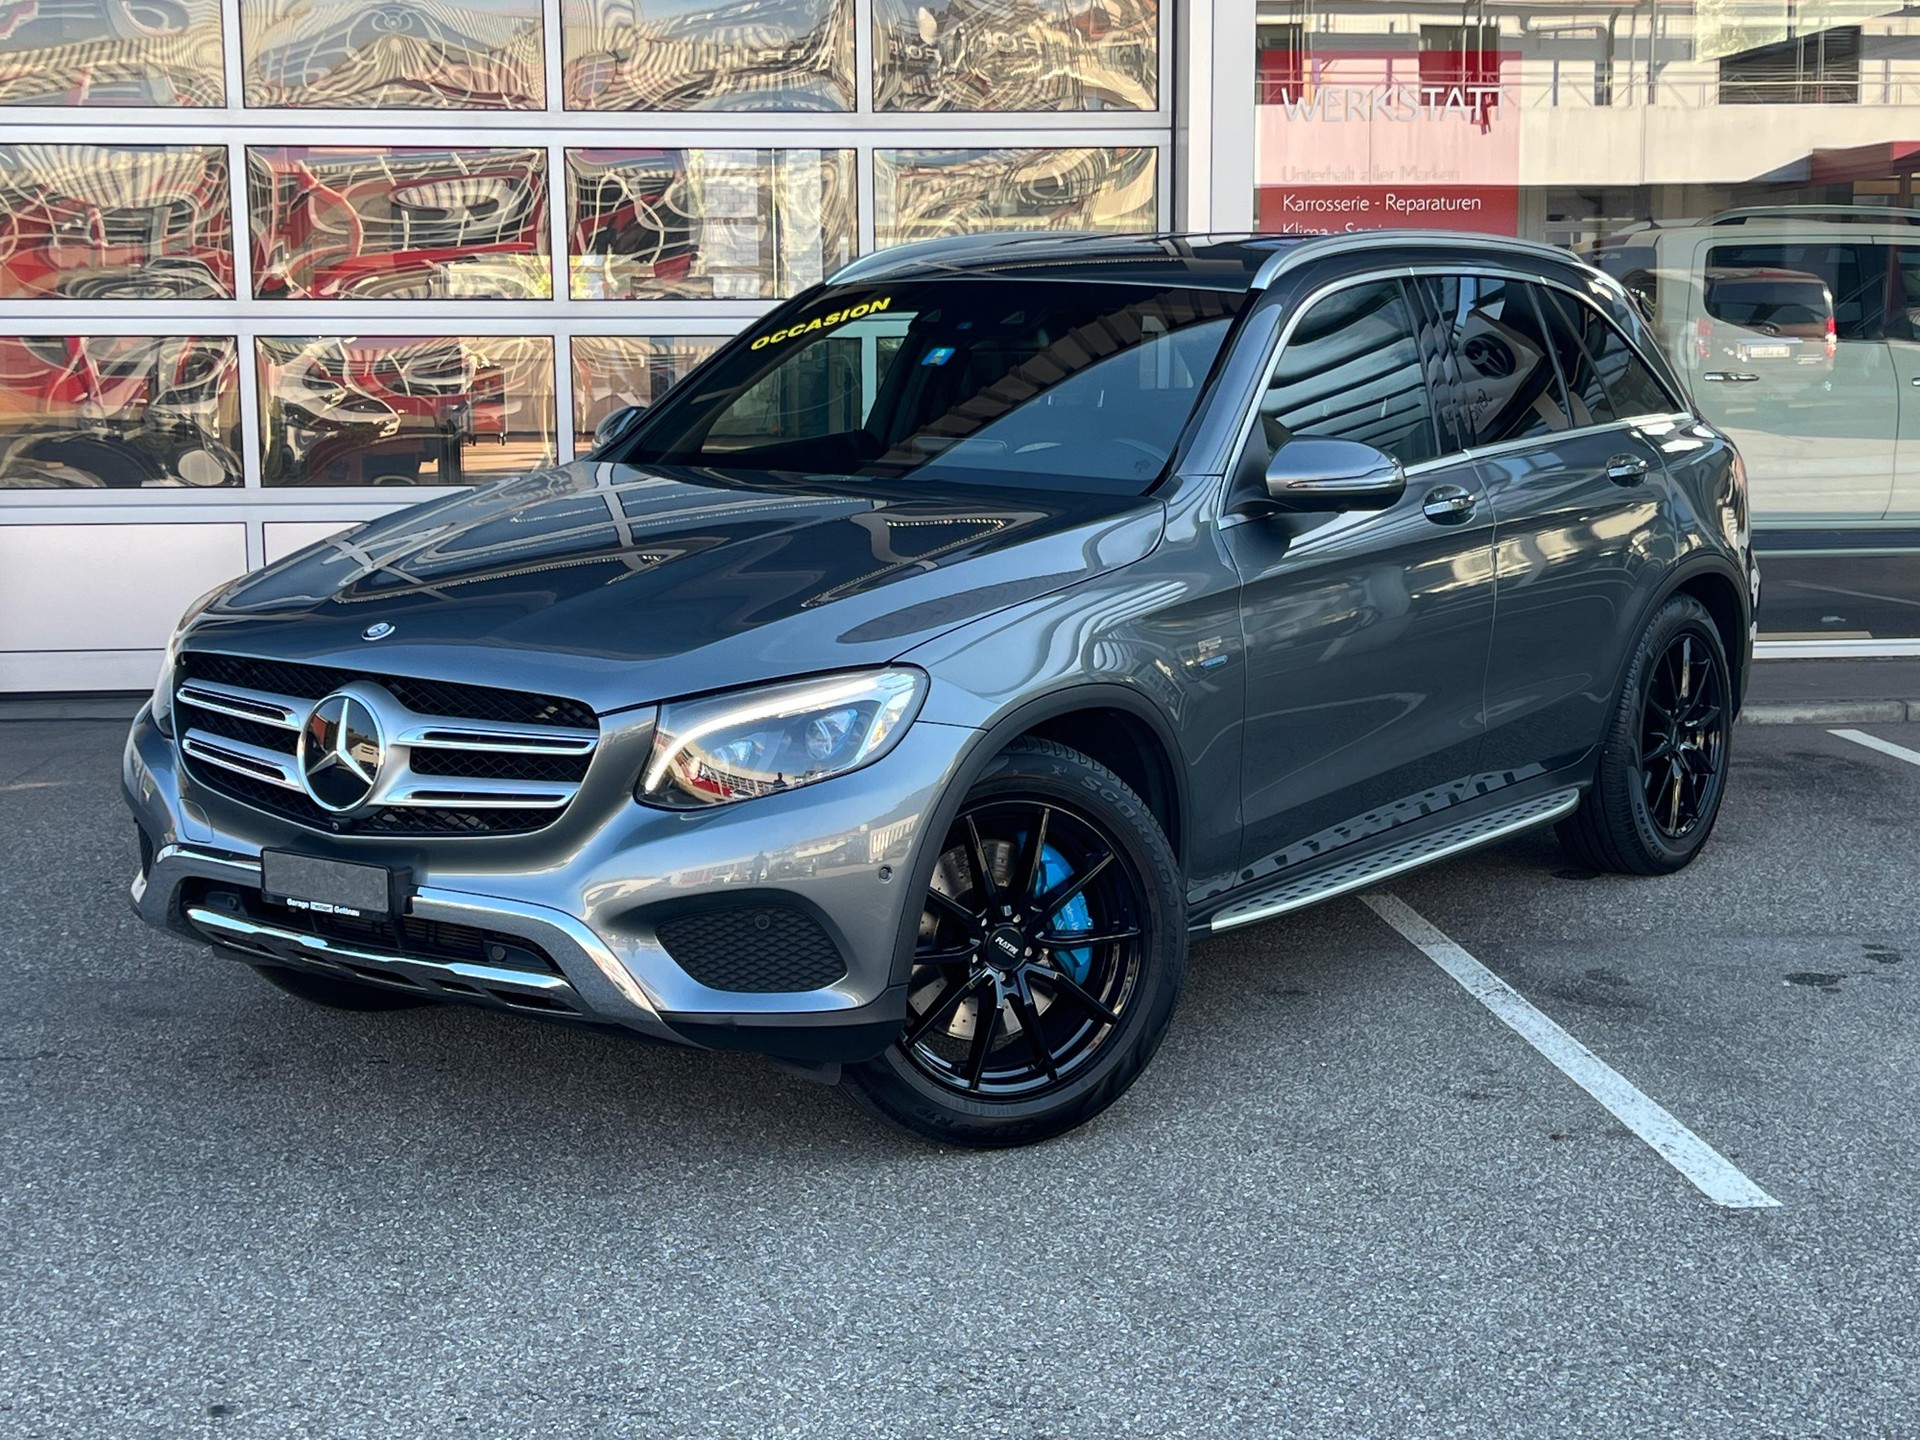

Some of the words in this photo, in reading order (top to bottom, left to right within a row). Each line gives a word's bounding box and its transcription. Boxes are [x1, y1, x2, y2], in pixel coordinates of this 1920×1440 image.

[1281, 87, 1511, 123] WERKSTATT
[1281, 165, 1355, 182] Unterhalt
[1401, 165, 1460, 182] Marken
[1282, 193, 1370, 212] Karrosserie
[1385, 193, 1482, 216] Reparaturen
[751, 297, 891, 351] OCCASION
